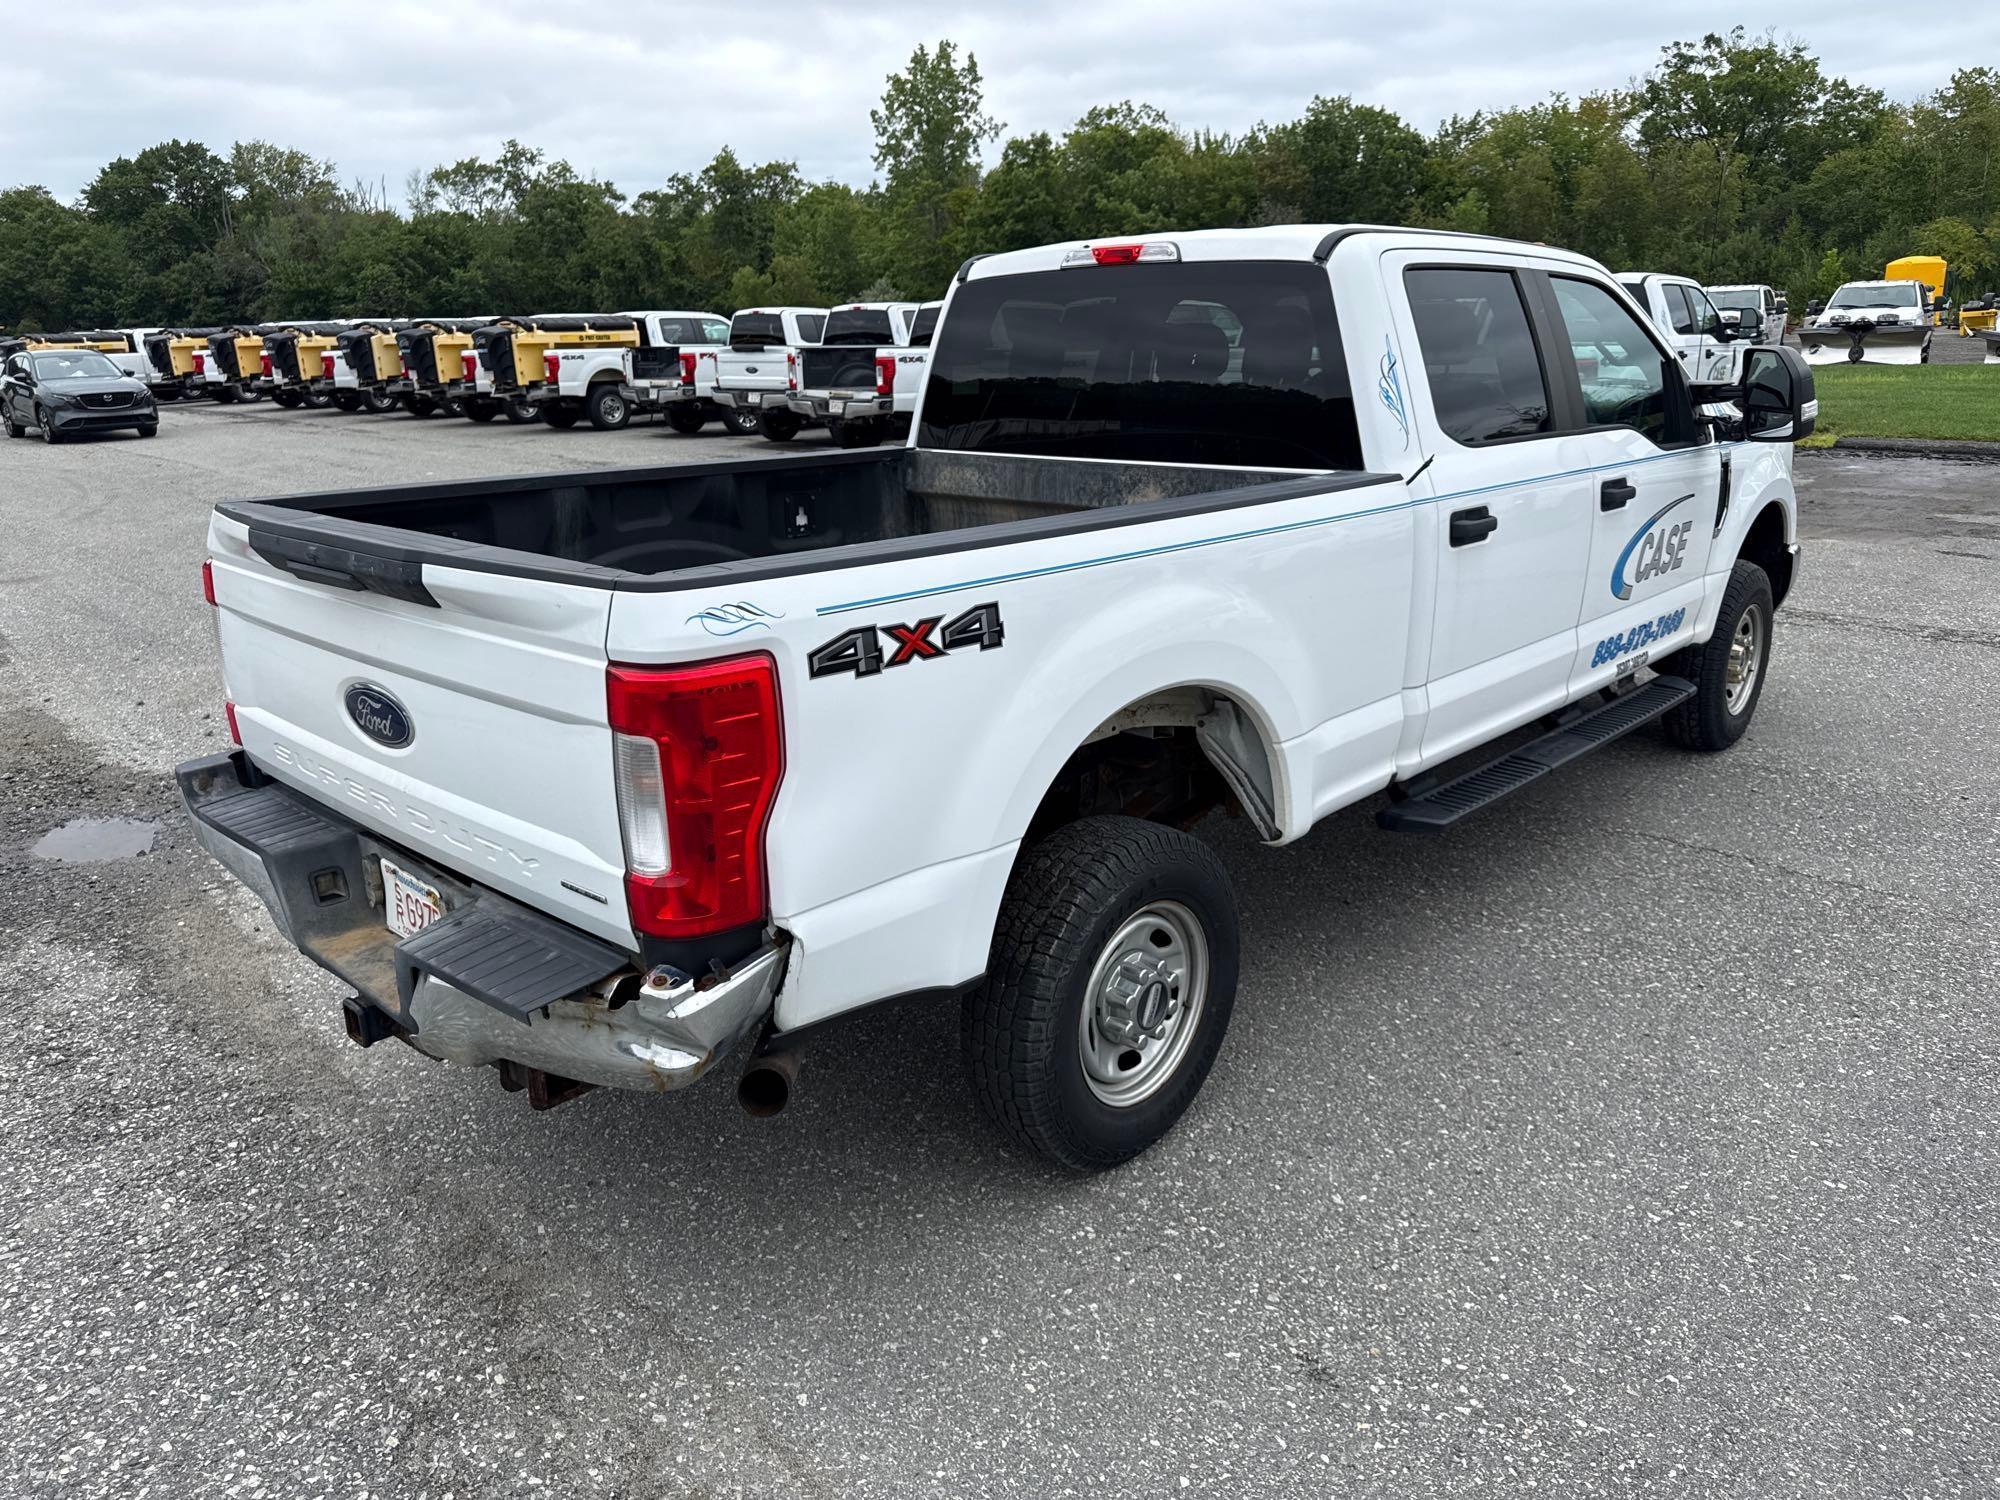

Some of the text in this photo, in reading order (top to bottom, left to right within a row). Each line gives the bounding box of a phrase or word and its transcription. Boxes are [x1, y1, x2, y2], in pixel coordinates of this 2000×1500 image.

[1634, 520, 1693, 583] CASE
[806, 600, 1005, 680] 4X4
[355, 695, 393, 737] Ford
[273, 742, 541, 878] SUPER DUTY
